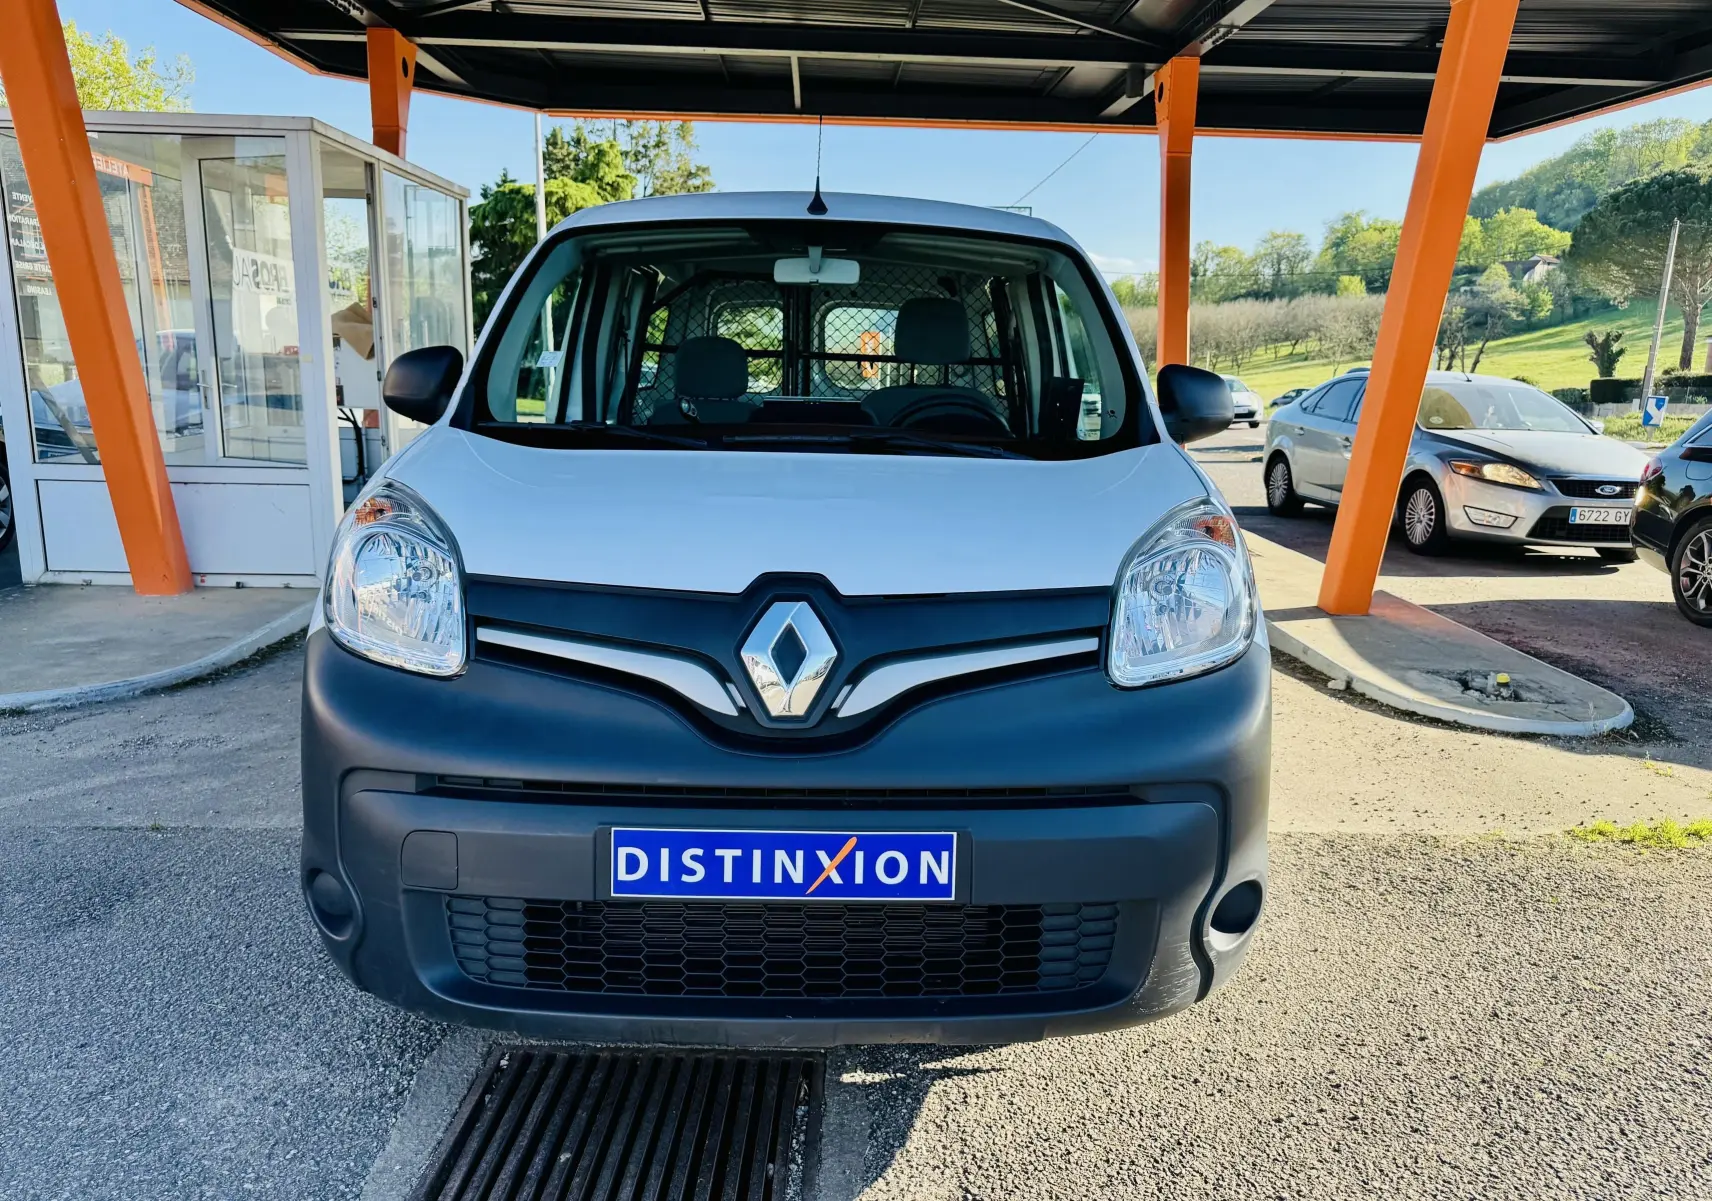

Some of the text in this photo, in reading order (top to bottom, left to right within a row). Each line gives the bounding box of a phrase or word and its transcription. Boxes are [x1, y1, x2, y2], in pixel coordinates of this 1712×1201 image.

[1579, 509, 1630, 523] 6722 GY
[617, 837, 949, 894] DISTINXION
